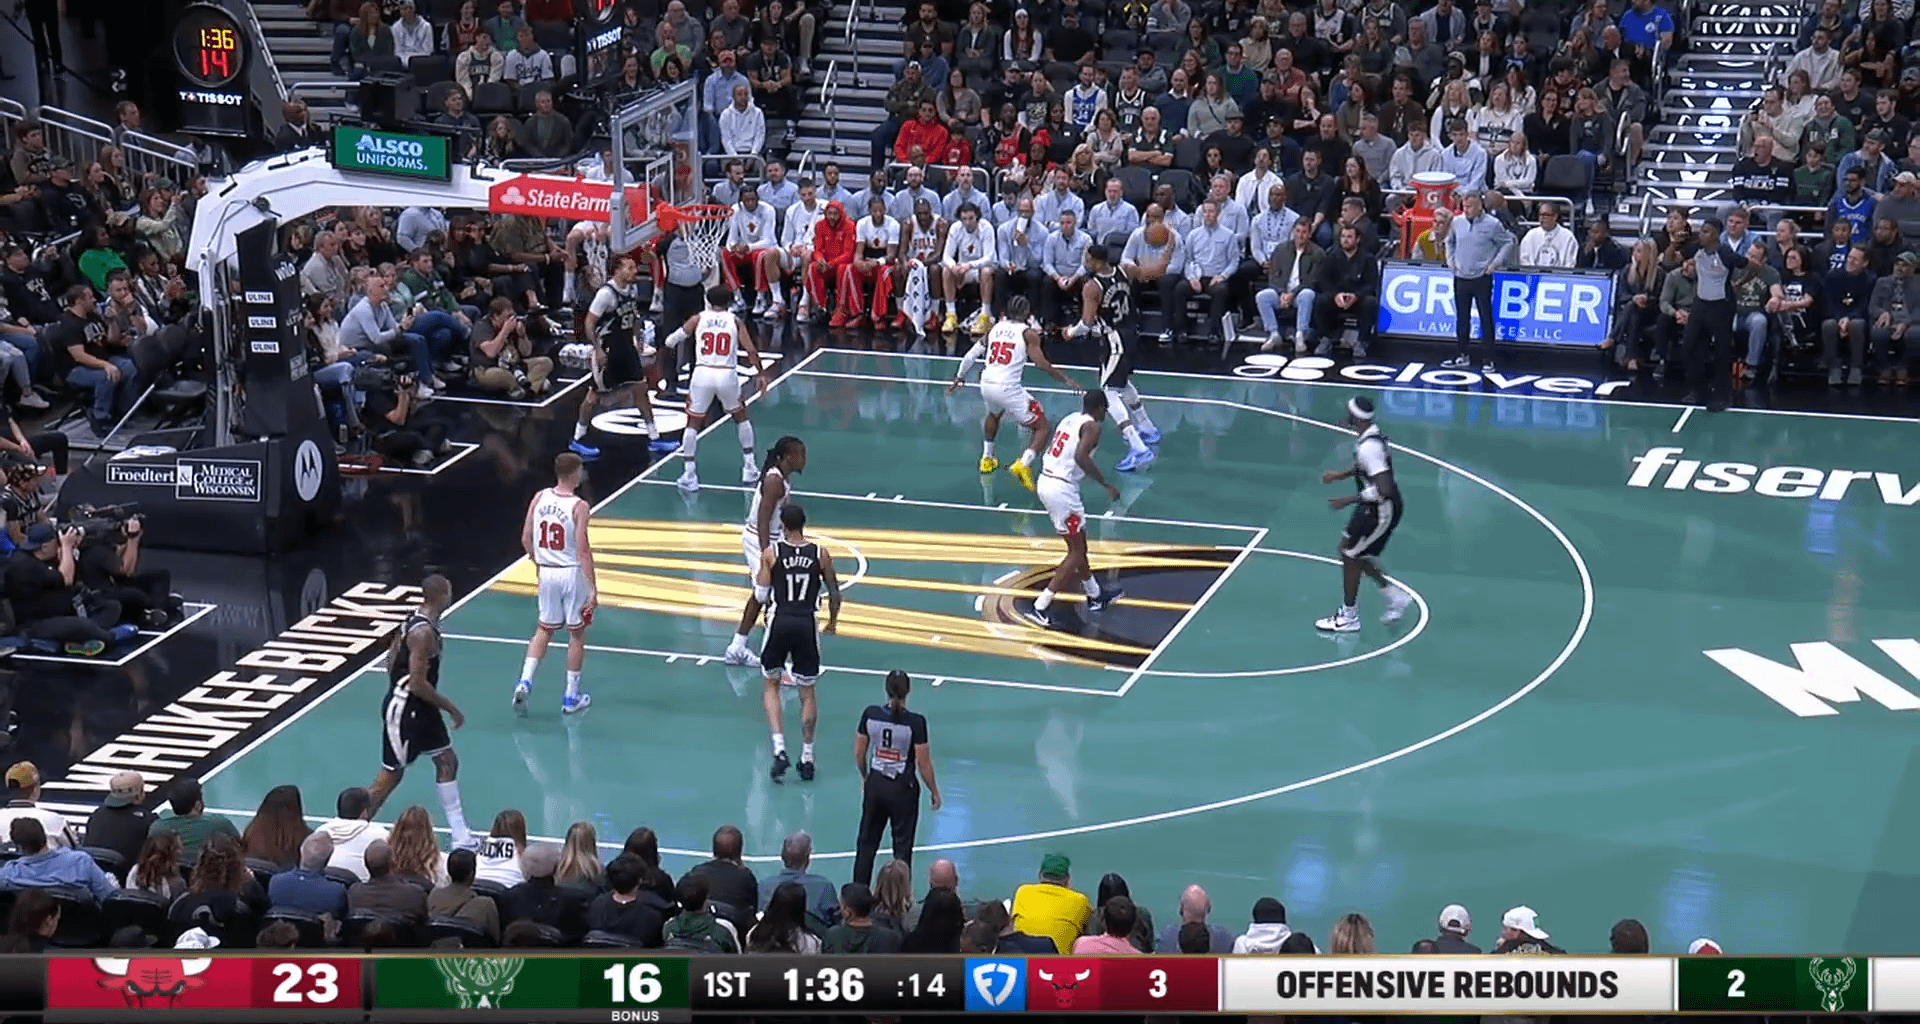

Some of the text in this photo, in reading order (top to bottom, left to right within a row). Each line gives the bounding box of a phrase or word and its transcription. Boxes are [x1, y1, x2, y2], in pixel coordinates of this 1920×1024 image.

[201, 28, 234, 49] 1:36
[202, 49, 228, 77] 14
[355, 134, 423, 157] ALSCO
[1427, 191, 1438, 203] G
[247, 293, 273, 302] ULINE
[1386, 274, 1602, 324] GRBER
[1111, 296, 1130, 324] 34
[250, 318, 276, 327] ULINE
[1419, 321, 1452, 333] LAW
[1534, 328, 1562, 341] LLC
[252, 342, 278, 352] ULINE
[701, 332, 731, 356] 30
[989, 341, 1016, 366] 35
[1340, 362, 1631, 397] clover
[111, 466, 175, 483] Froedtert
[1626, 446, 1920, 506] fiserv
[539, 520, 565, 551] 13
[782, 556, 815, 570] COFFEY
[785, 573, 811, 601] 17
[235, 581, 426, 673] BUCKS
[882, 728, 892, 748] 9
